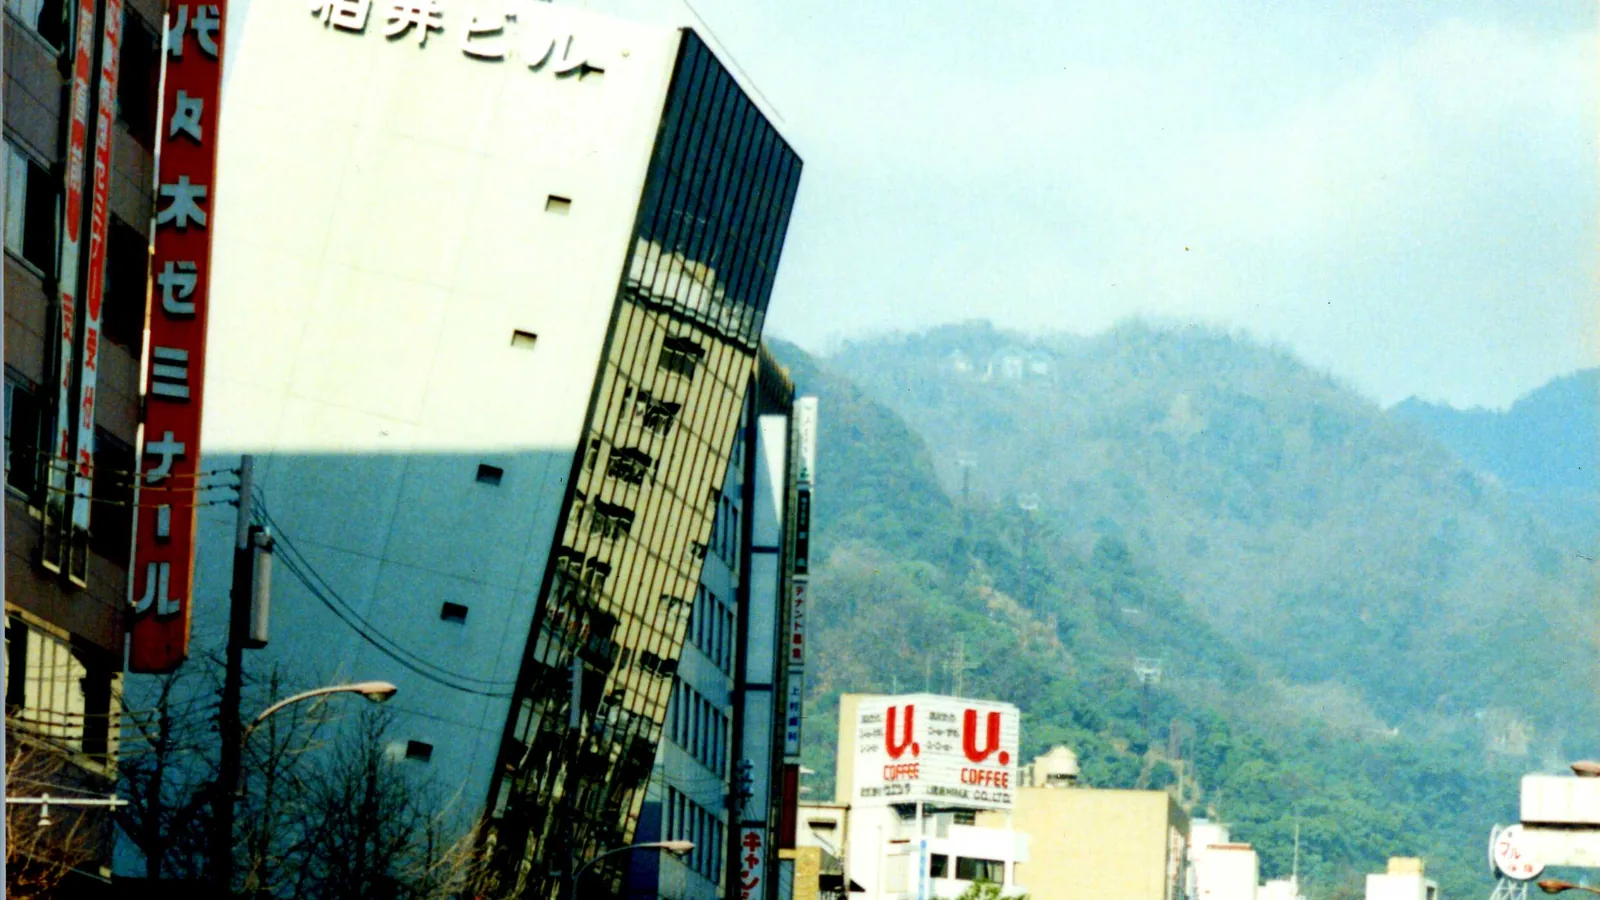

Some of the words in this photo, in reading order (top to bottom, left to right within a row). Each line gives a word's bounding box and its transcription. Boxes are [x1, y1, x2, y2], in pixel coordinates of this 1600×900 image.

[135, 4, 220, 615] 代々木ゼミナール
[883, 763, 920, 781] COFFEE
[961, 767, 1010, 790] COFFEE
